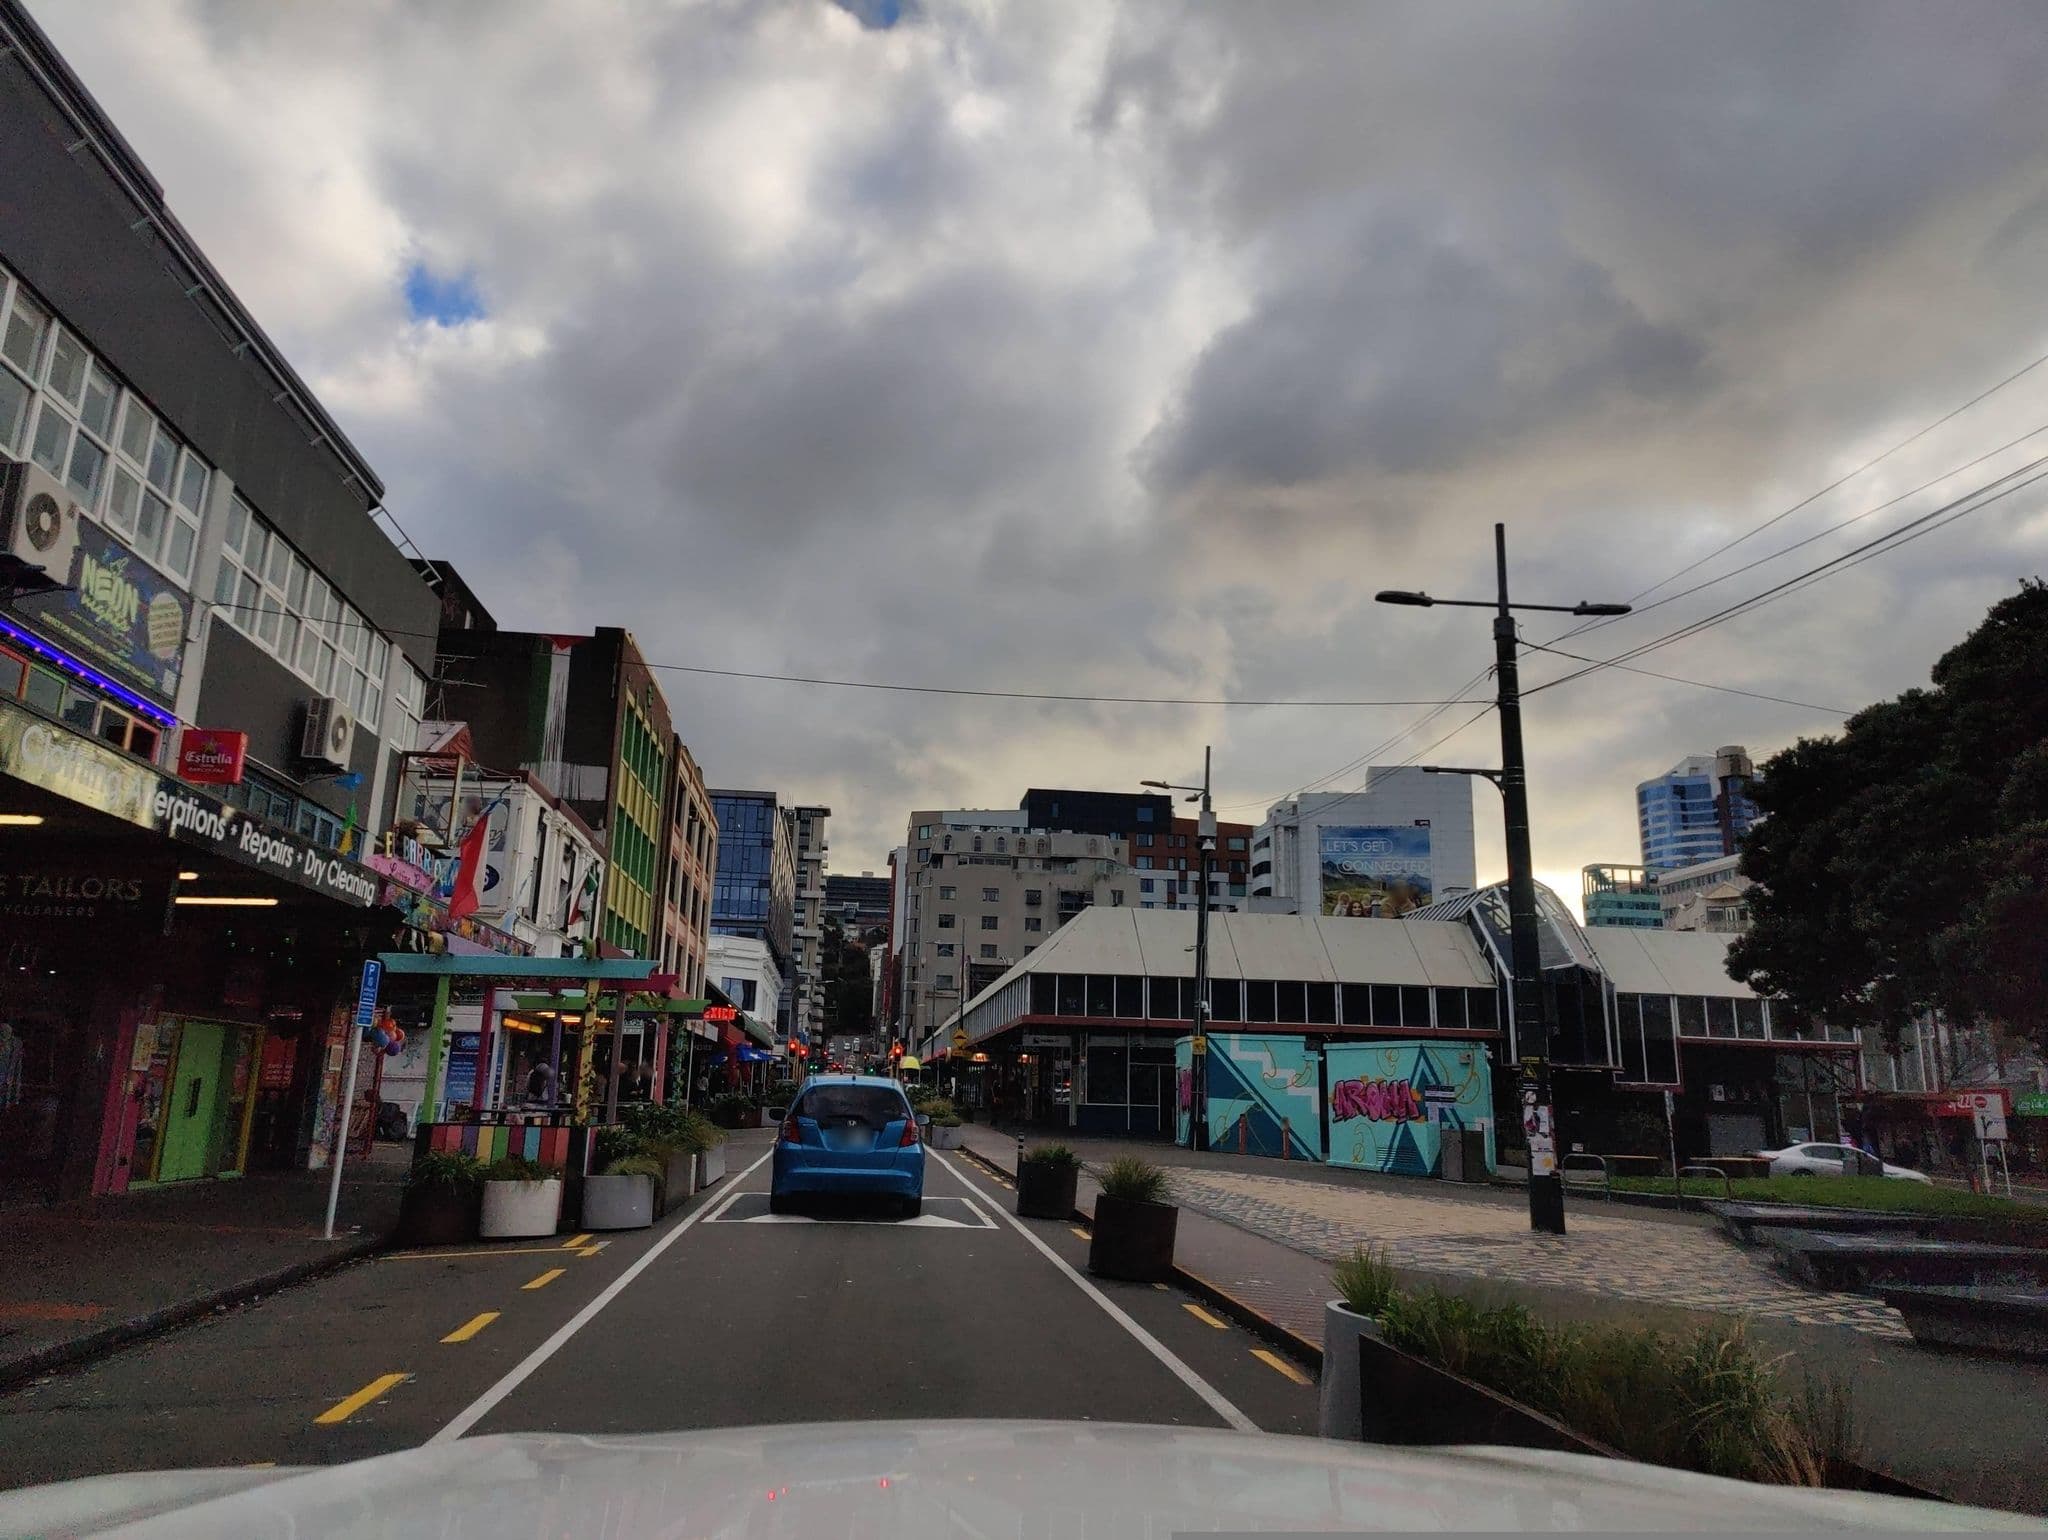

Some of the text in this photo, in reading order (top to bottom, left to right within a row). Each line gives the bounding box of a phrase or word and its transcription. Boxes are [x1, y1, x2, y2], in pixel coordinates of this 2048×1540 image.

[80, 552, 140, 624] NEON
[184, 750, 233, 765] Estrella
[1326, 840, 1387, 852] LET'S GET
[239, 820, 294, 867] Repairs
[303, 848, 327, 886] Dry
[326, 858, 376, 907] Cleaning
[1341, 860, 1428, 872] CONNECTED
[17, 874, 143, 901] TAILORS
[368, 963, 376, 976] P
[703, 1006, 735, 1021] EXICO
